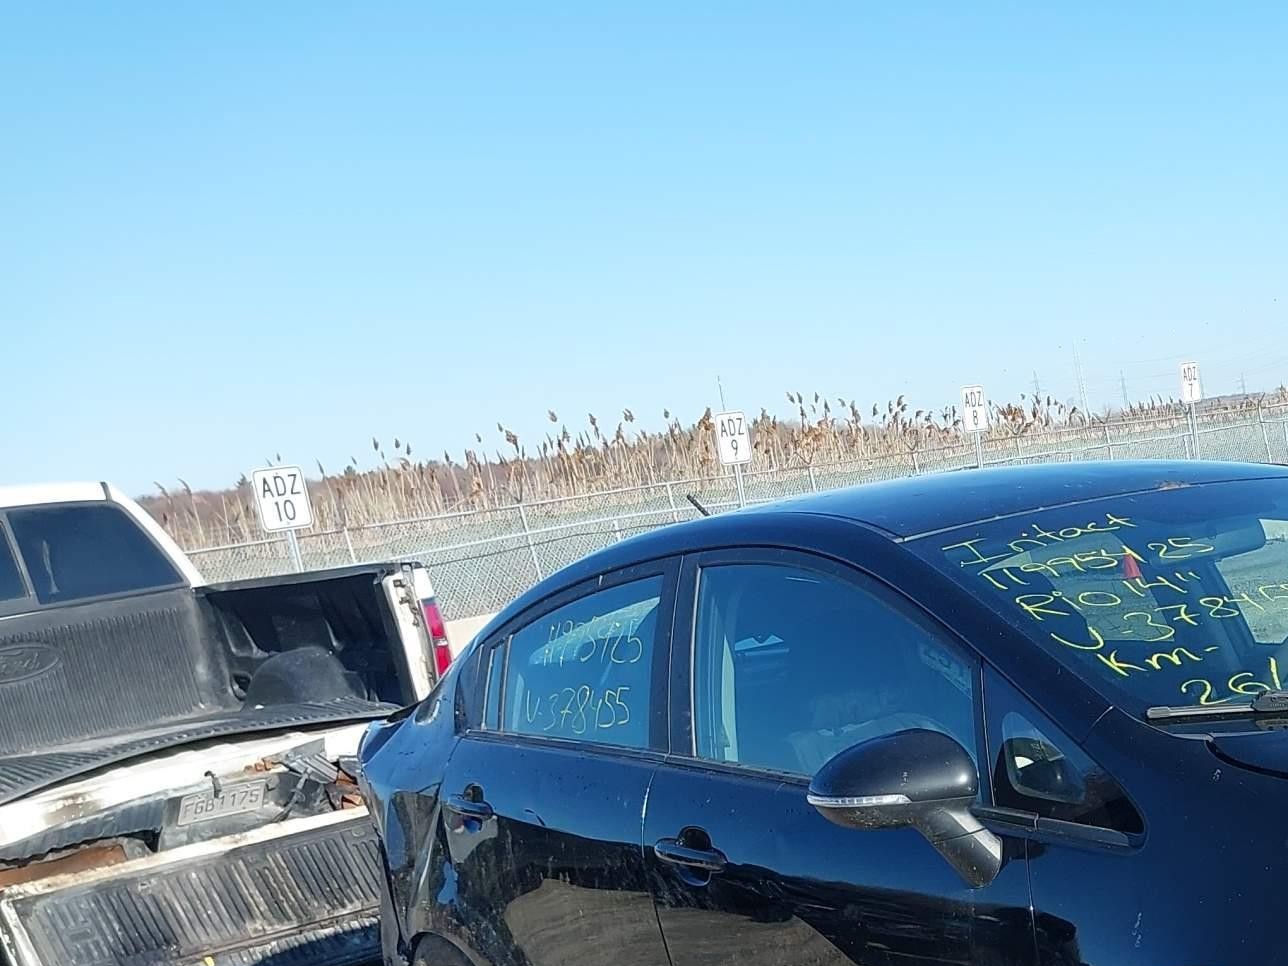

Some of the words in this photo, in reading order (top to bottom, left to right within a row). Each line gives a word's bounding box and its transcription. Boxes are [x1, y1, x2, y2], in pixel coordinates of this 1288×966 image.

[1183, 366, 1197, 381] ADZ
[965, 391, 983, 407] ADZ
[1188, 382, 1193, 398] 7
[720, 417, 745, 437] ADZ
[972, 409, 979, 426] 8
[731, 439, 738, 457] 9
[262, 473, 302, 498] ADZ
[274, 499, 296, 522] 10
[942, 513, 1138, 568] Intact
[1015, 590, 1122, 621] Rio
